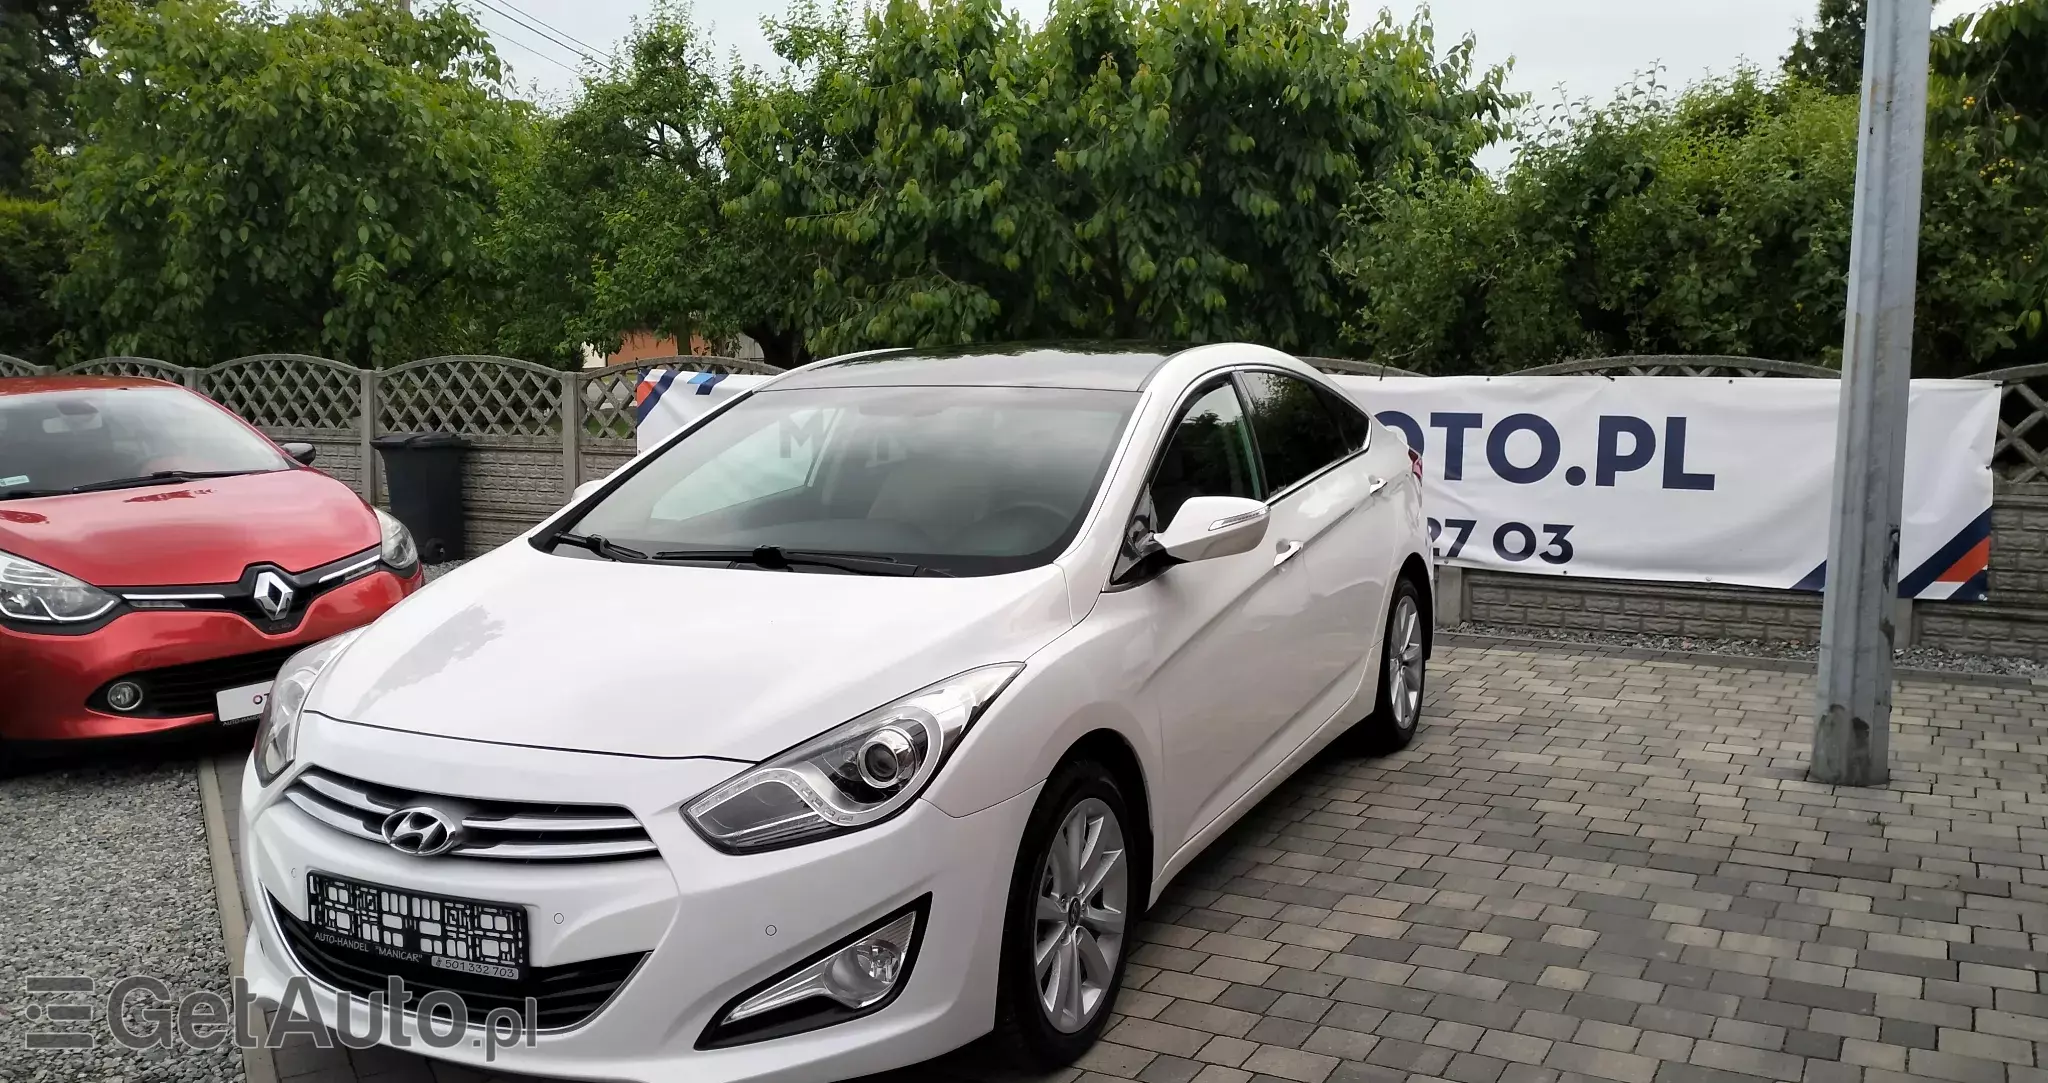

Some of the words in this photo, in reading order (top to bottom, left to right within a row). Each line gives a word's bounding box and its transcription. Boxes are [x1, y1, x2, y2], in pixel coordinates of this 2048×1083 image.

[314, 931, 370, 953] AUTO-HANDEL
[445, 959, 466, 971] 501
[468, 963, 490, 975] 332
[492, 966, 515, 978] 703
